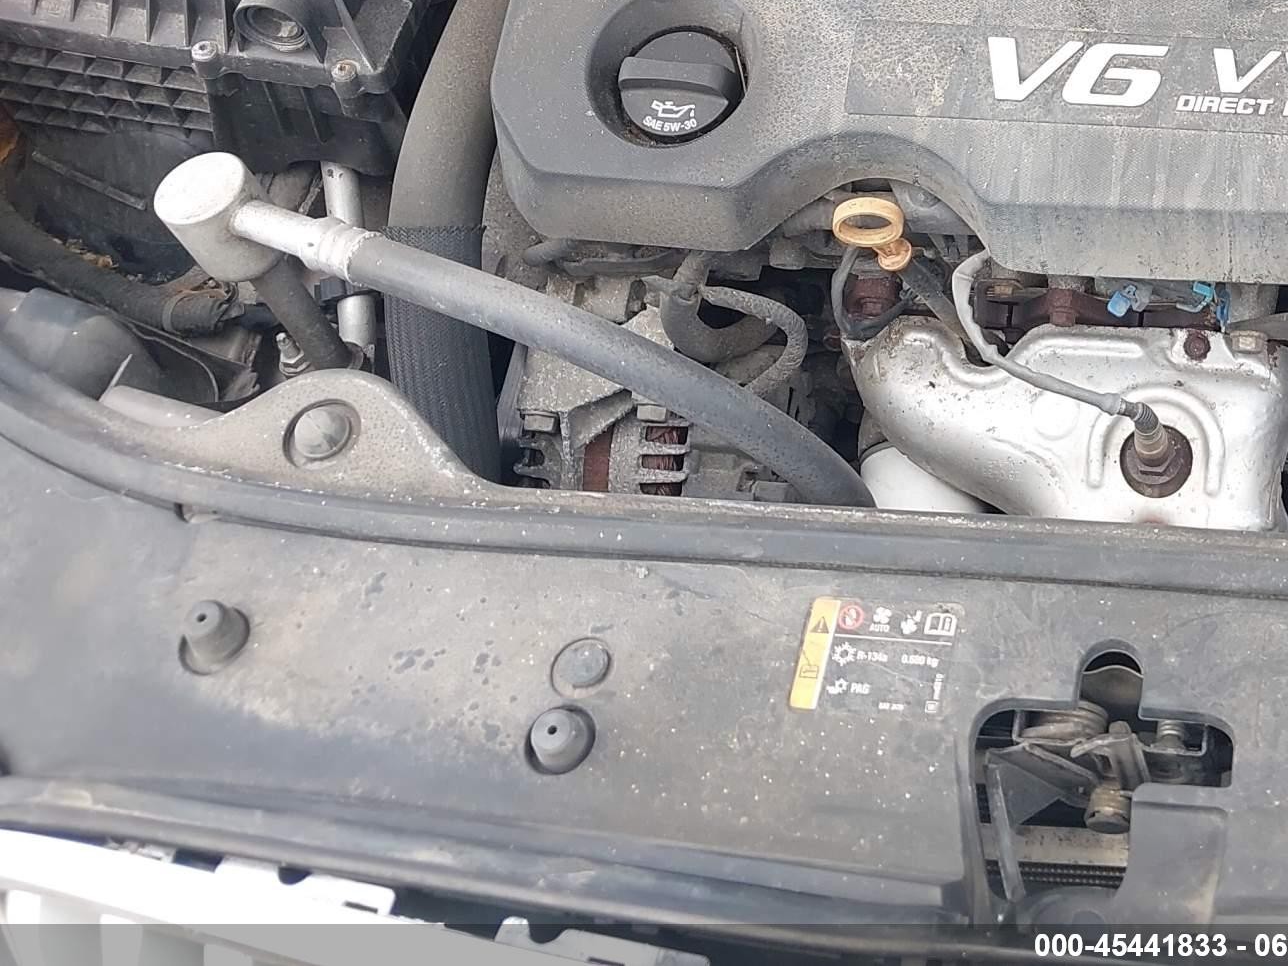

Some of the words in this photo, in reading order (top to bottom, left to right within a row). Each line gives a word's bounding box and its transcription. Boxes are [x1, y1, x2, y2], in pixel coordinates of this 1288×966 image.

[987, 36, 1170, 108] V6
[1175, 95, 1274, 117] DIRECT
[642, 115, 664, 131] SAE
[663, 118, 697, 132] 5W-30
[869, 624, 890, 633] AUTO
[856, 651, 888, 663] R-134a
[926, 656, 940, 669] kg
[850, 682, 871, 695] PAG
